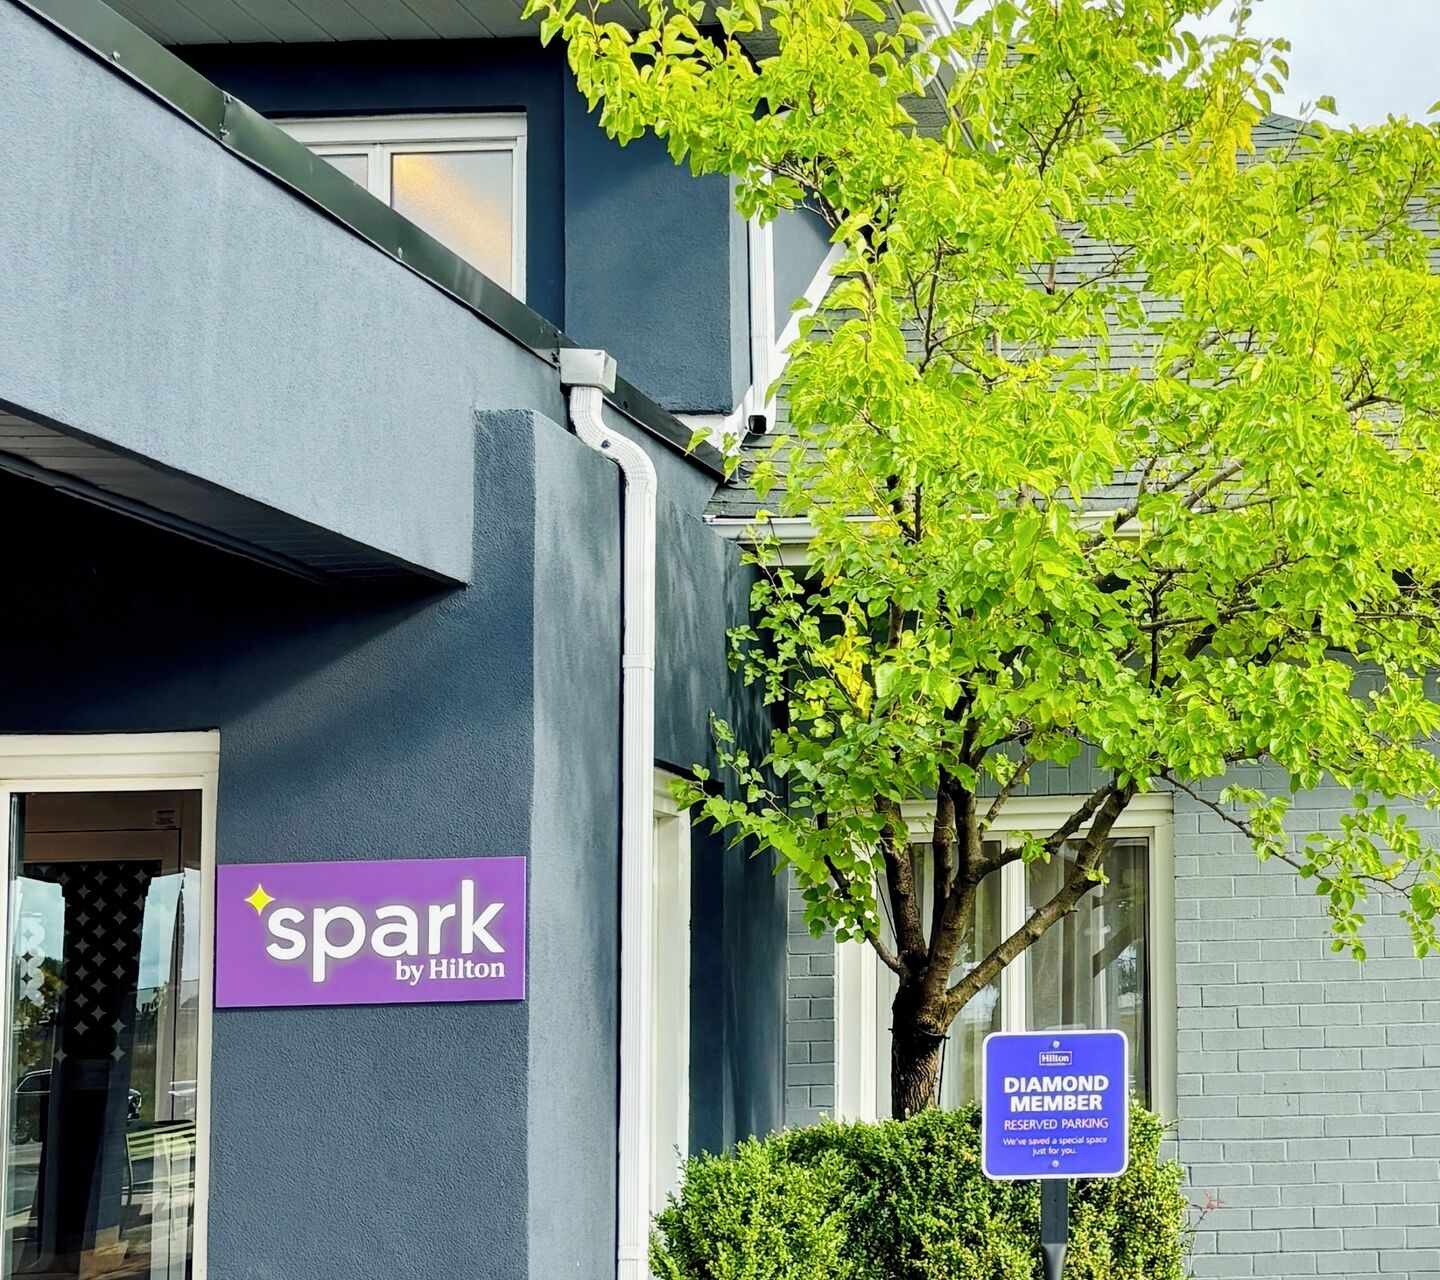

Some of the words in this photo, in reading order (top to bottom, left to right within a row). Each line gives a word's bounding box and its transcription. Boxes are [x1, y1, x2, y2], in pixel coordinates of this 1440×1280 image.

[266, 879, 505, 983] spark
[396, 960, 424, 986] by
[429, 958, 506, 980] Hilton
[1041, 1054, 1070, 1062] Hilton
[1004, 1075, 1109, 1093] DIAMOND
[1010, 1095, 1102, 1112] MEMBER
[1004, 1119, 1058, 1130] RESERVED
[1062, 1118, 1109, 1129] PARKING
[1059, 1136, 1084, 1147] special
[1086, 1137, 1107, 1145] space
[1032, 1147, 1046, 1157] just
[1048, 1147, 1059, 1155] for
[1061, 1148, 1078, 1157] you.
